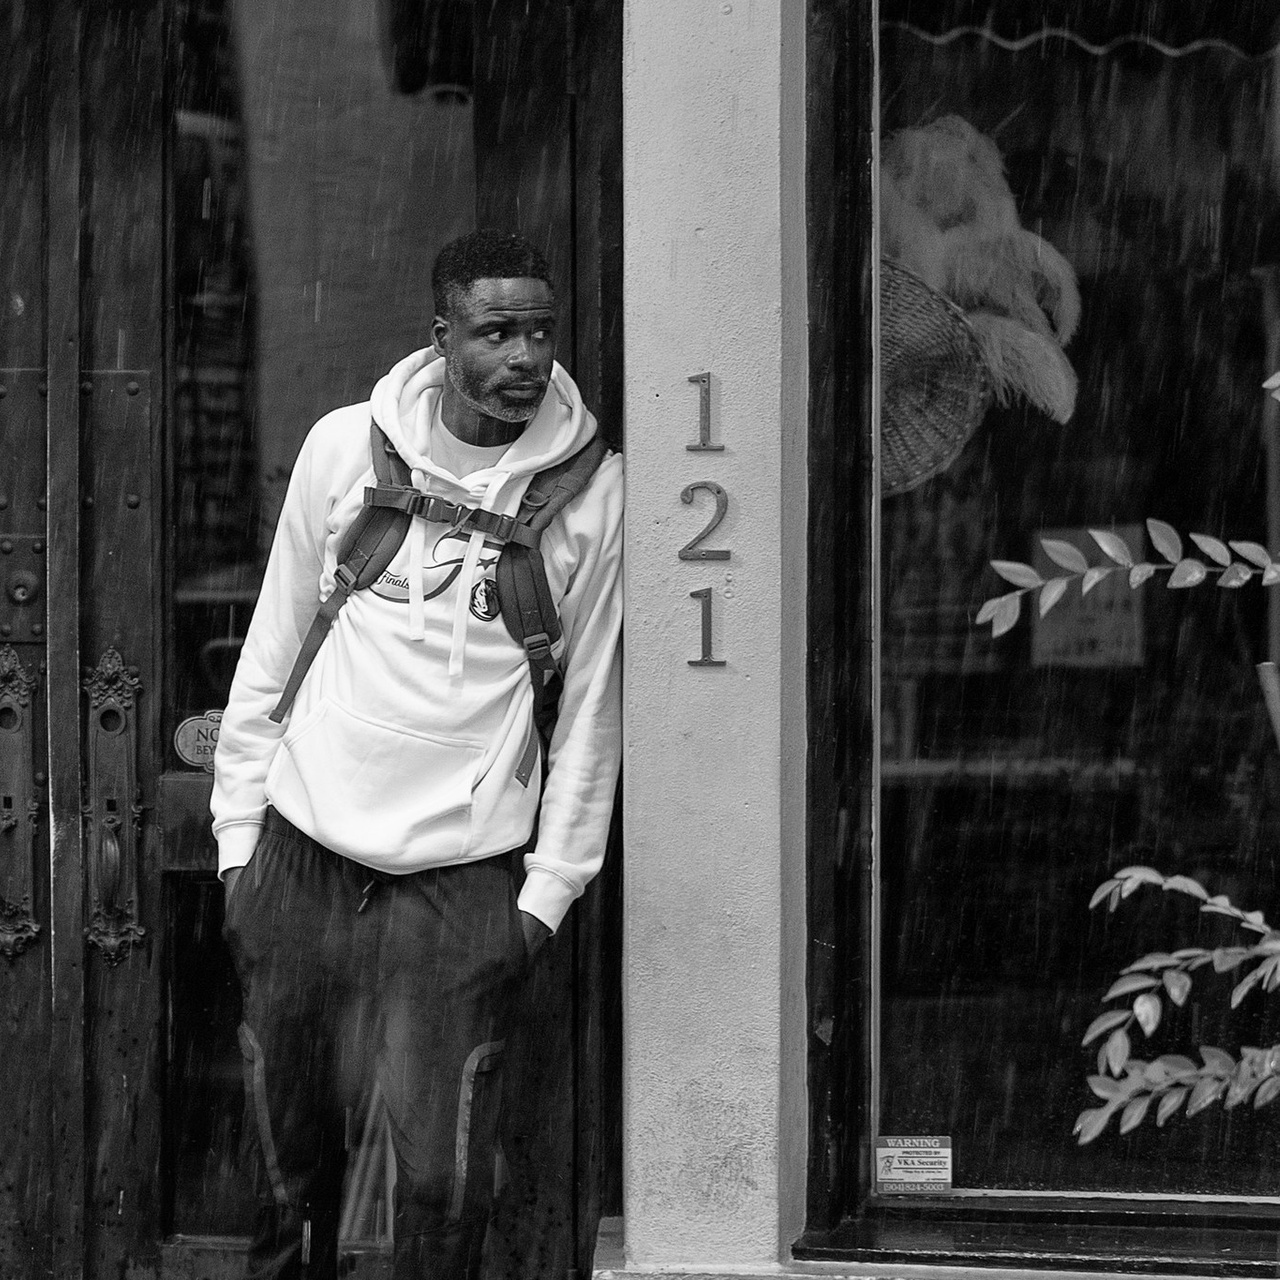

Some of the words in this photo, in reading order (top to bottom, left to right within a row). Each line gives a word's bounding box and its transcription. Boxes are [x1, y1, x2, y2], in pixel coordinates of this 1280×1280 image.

[196, 745, 217, 755] BEY
[886, 1138, 941, 1148] WARNING
[917, 1159, 947, 1168] Security
